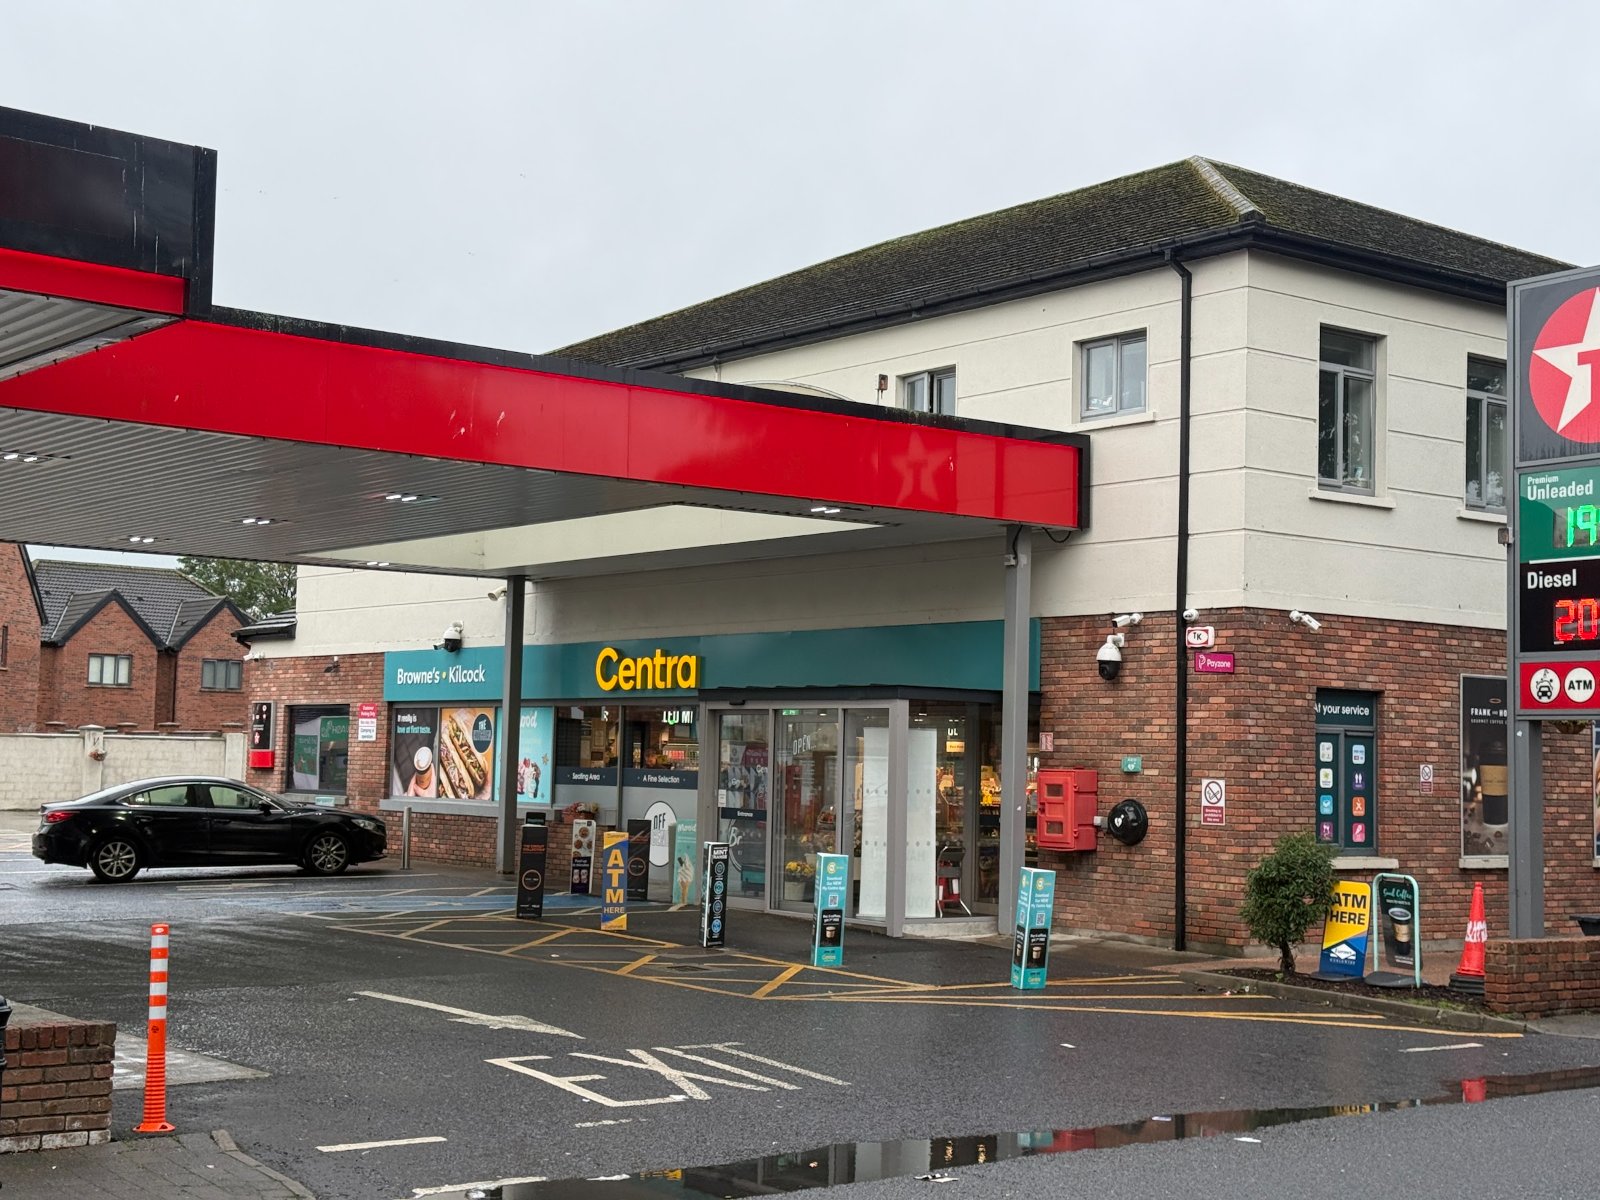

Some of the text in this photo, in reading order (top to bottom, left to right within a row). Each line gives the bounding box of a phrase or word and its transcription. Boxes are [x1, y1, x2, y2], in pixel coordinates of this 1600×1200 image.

[1527, 475, 1559, 486] Premium
[1527, 479, 1594, 501] Unleaded
[1567, 504, 1600, 548] 19
[1527, 568, 1577, 589] Diesel
[1555, 598, 1600, 641] 20
[595, 646, 697, 691] Centra
[1206, 659, 1231, 669] Payzone
[397, 664, 485, 685] Browne's Kilcock
[1568, 680, 1592, 690] ATM
[401, 714, 412, 724] really
[520, 710, 538, 728] ood
[1323, 704, 1340, 716] your
[1342, 705, 1370, 716] service
[1470, 708, 1490, 716] FRANK
[1499, 709, 1508, 717] HO
[572, 772, 589, 782] Seating
[654, 812, 666, 830] OFF
[606, 849, 624, 904] ATM
[1331, 892, 1366, 909] ATM
[1330, 910, 1366, 926] HERE
[485, 1042, 852, 1107] EXIT
